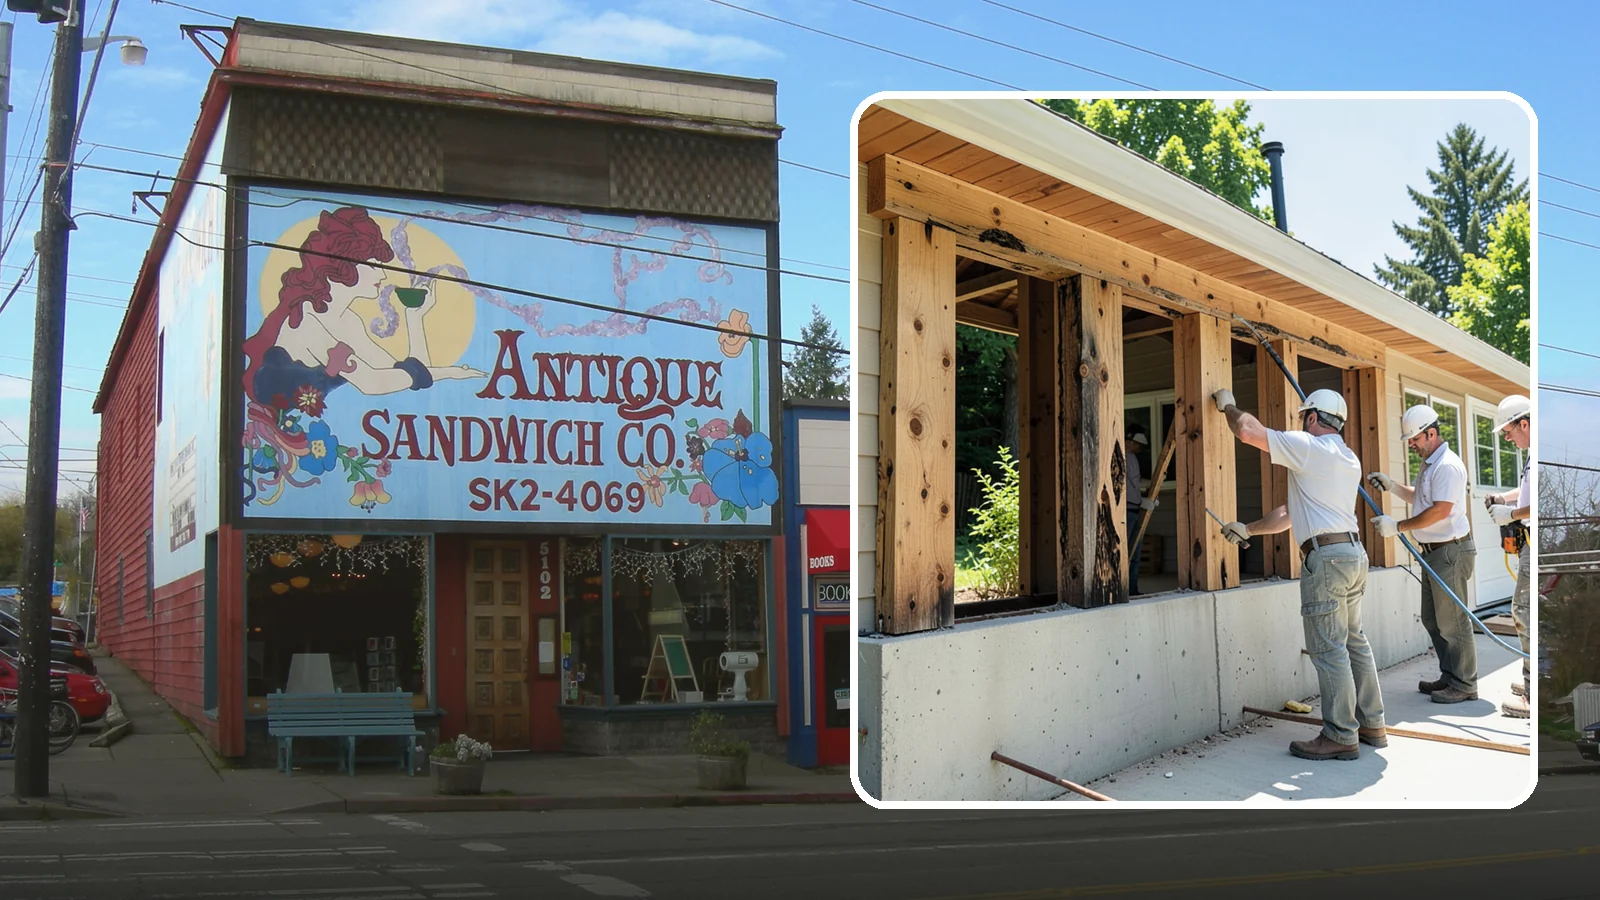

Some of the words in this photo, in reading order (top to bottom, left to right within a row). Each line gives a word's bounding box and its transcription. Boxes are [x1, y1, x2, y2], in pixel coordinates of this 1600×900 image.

[475, 328, 724, 421] ANTIQUE
[361, 408, 604, 468] SANDWICH
[616, 421, 685, 470] CO.
[468, 476, 646, 514] SK2-4069
[539, 541, 552, 600] 5102
[809, 555, 835, 569] BOOKS
